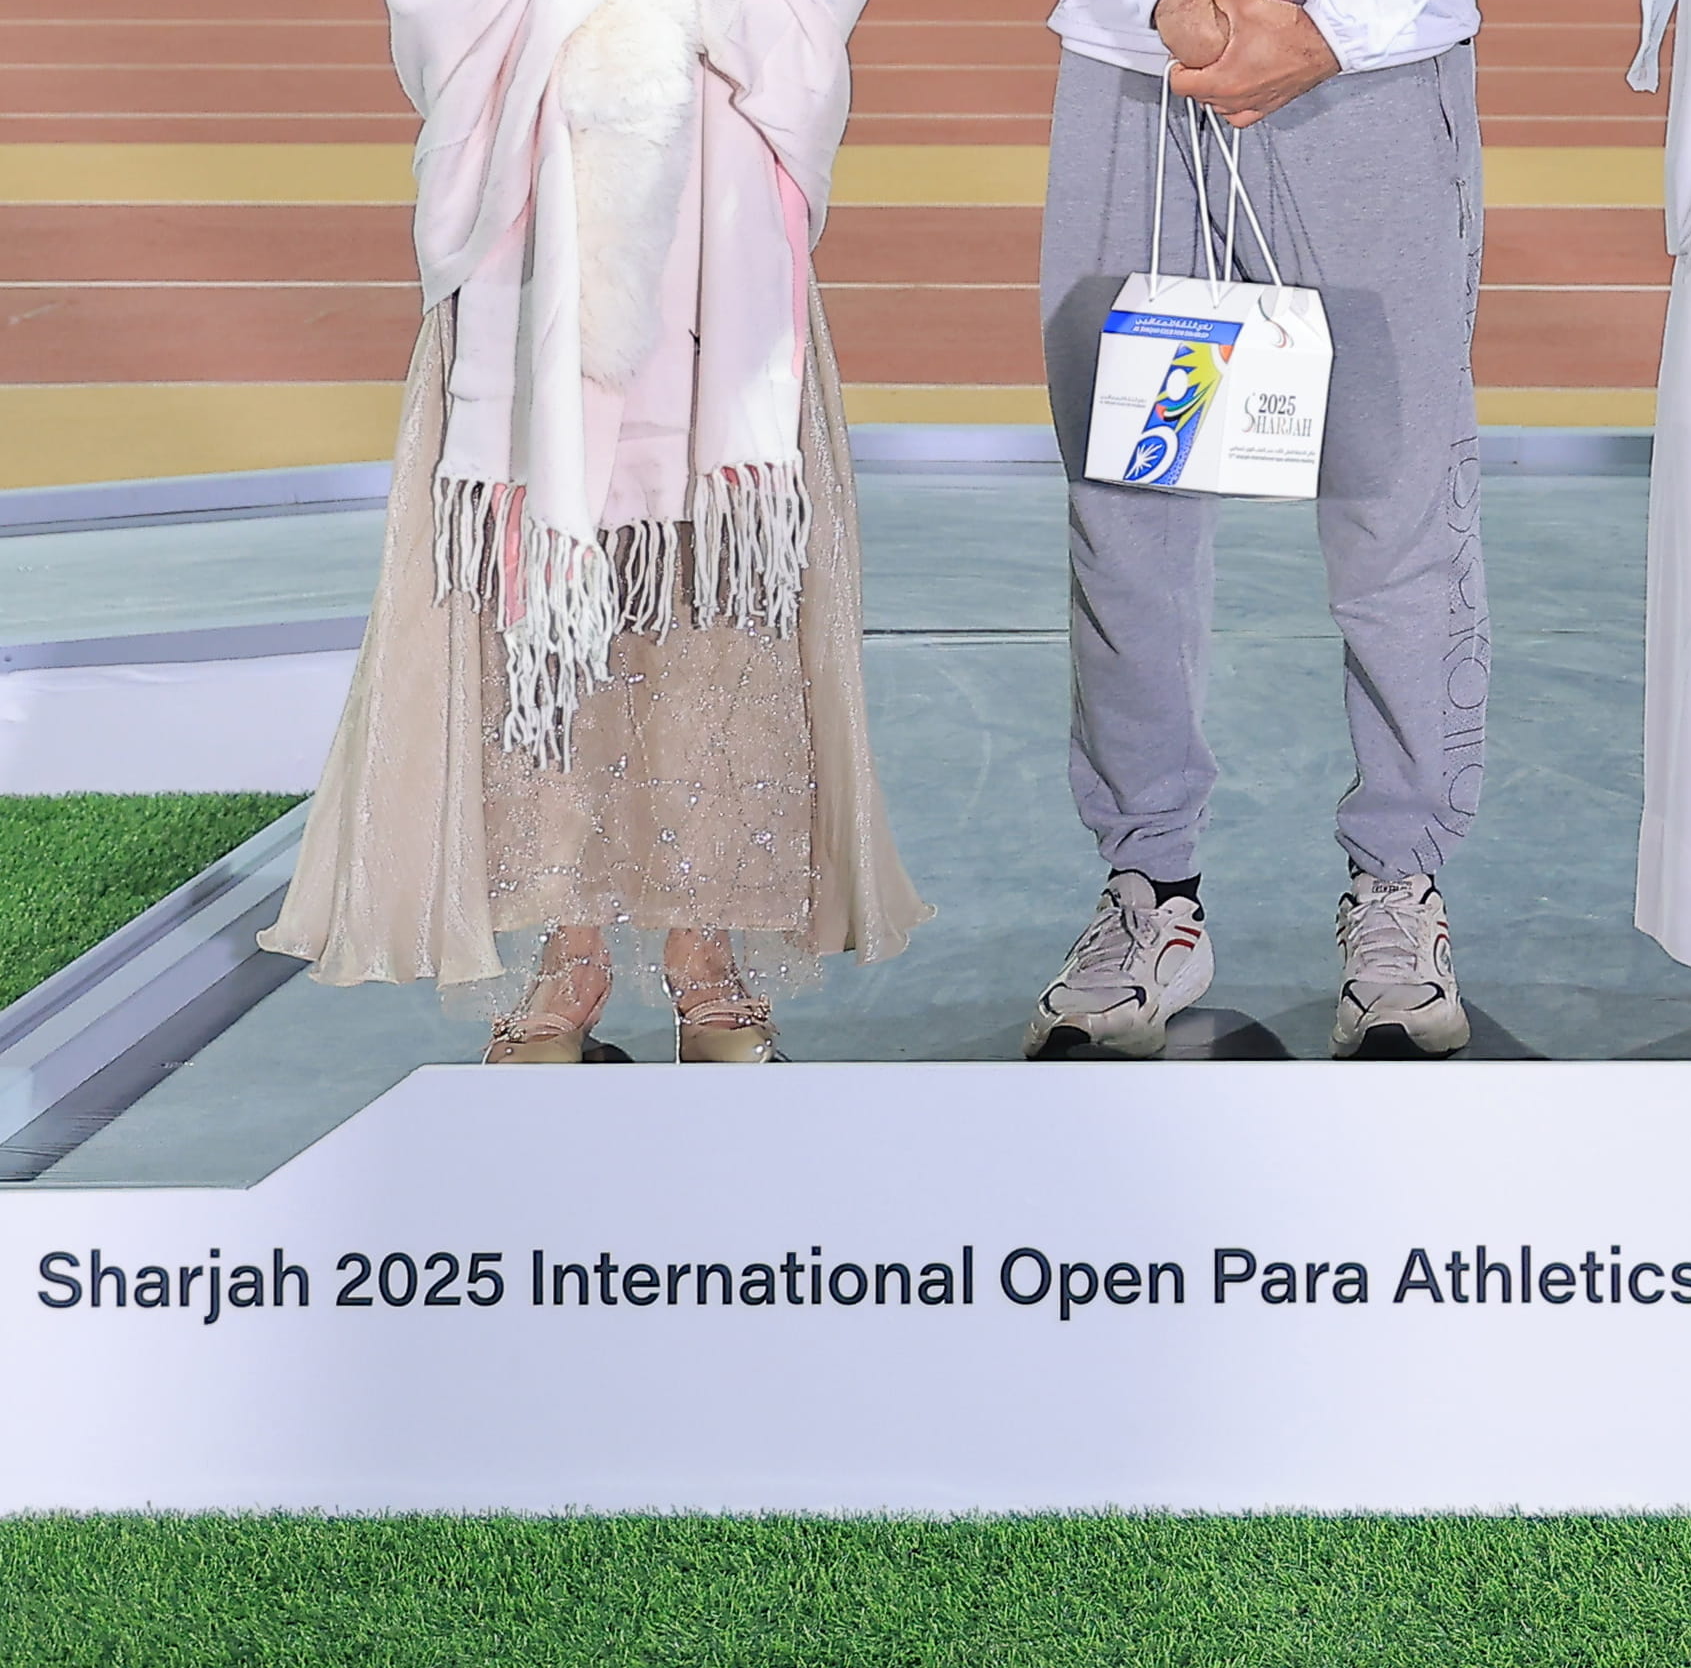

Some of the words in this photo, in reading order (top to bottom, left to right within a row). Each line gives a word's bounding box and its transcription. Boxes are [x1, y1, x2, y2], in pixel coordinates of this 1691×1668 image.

[1258, 393, 1297, 416] 2025
[1242, 411, 1312, 437] SHARJAH
[38, 1247, 310, 1325] Sharjah
[336, 1251, 505, 1308] 2025
[532, 1245, 974, 1307] International
[1000, 1246, 1185, 1321] Open
[1214, 1247, 1369, 1305] Para
